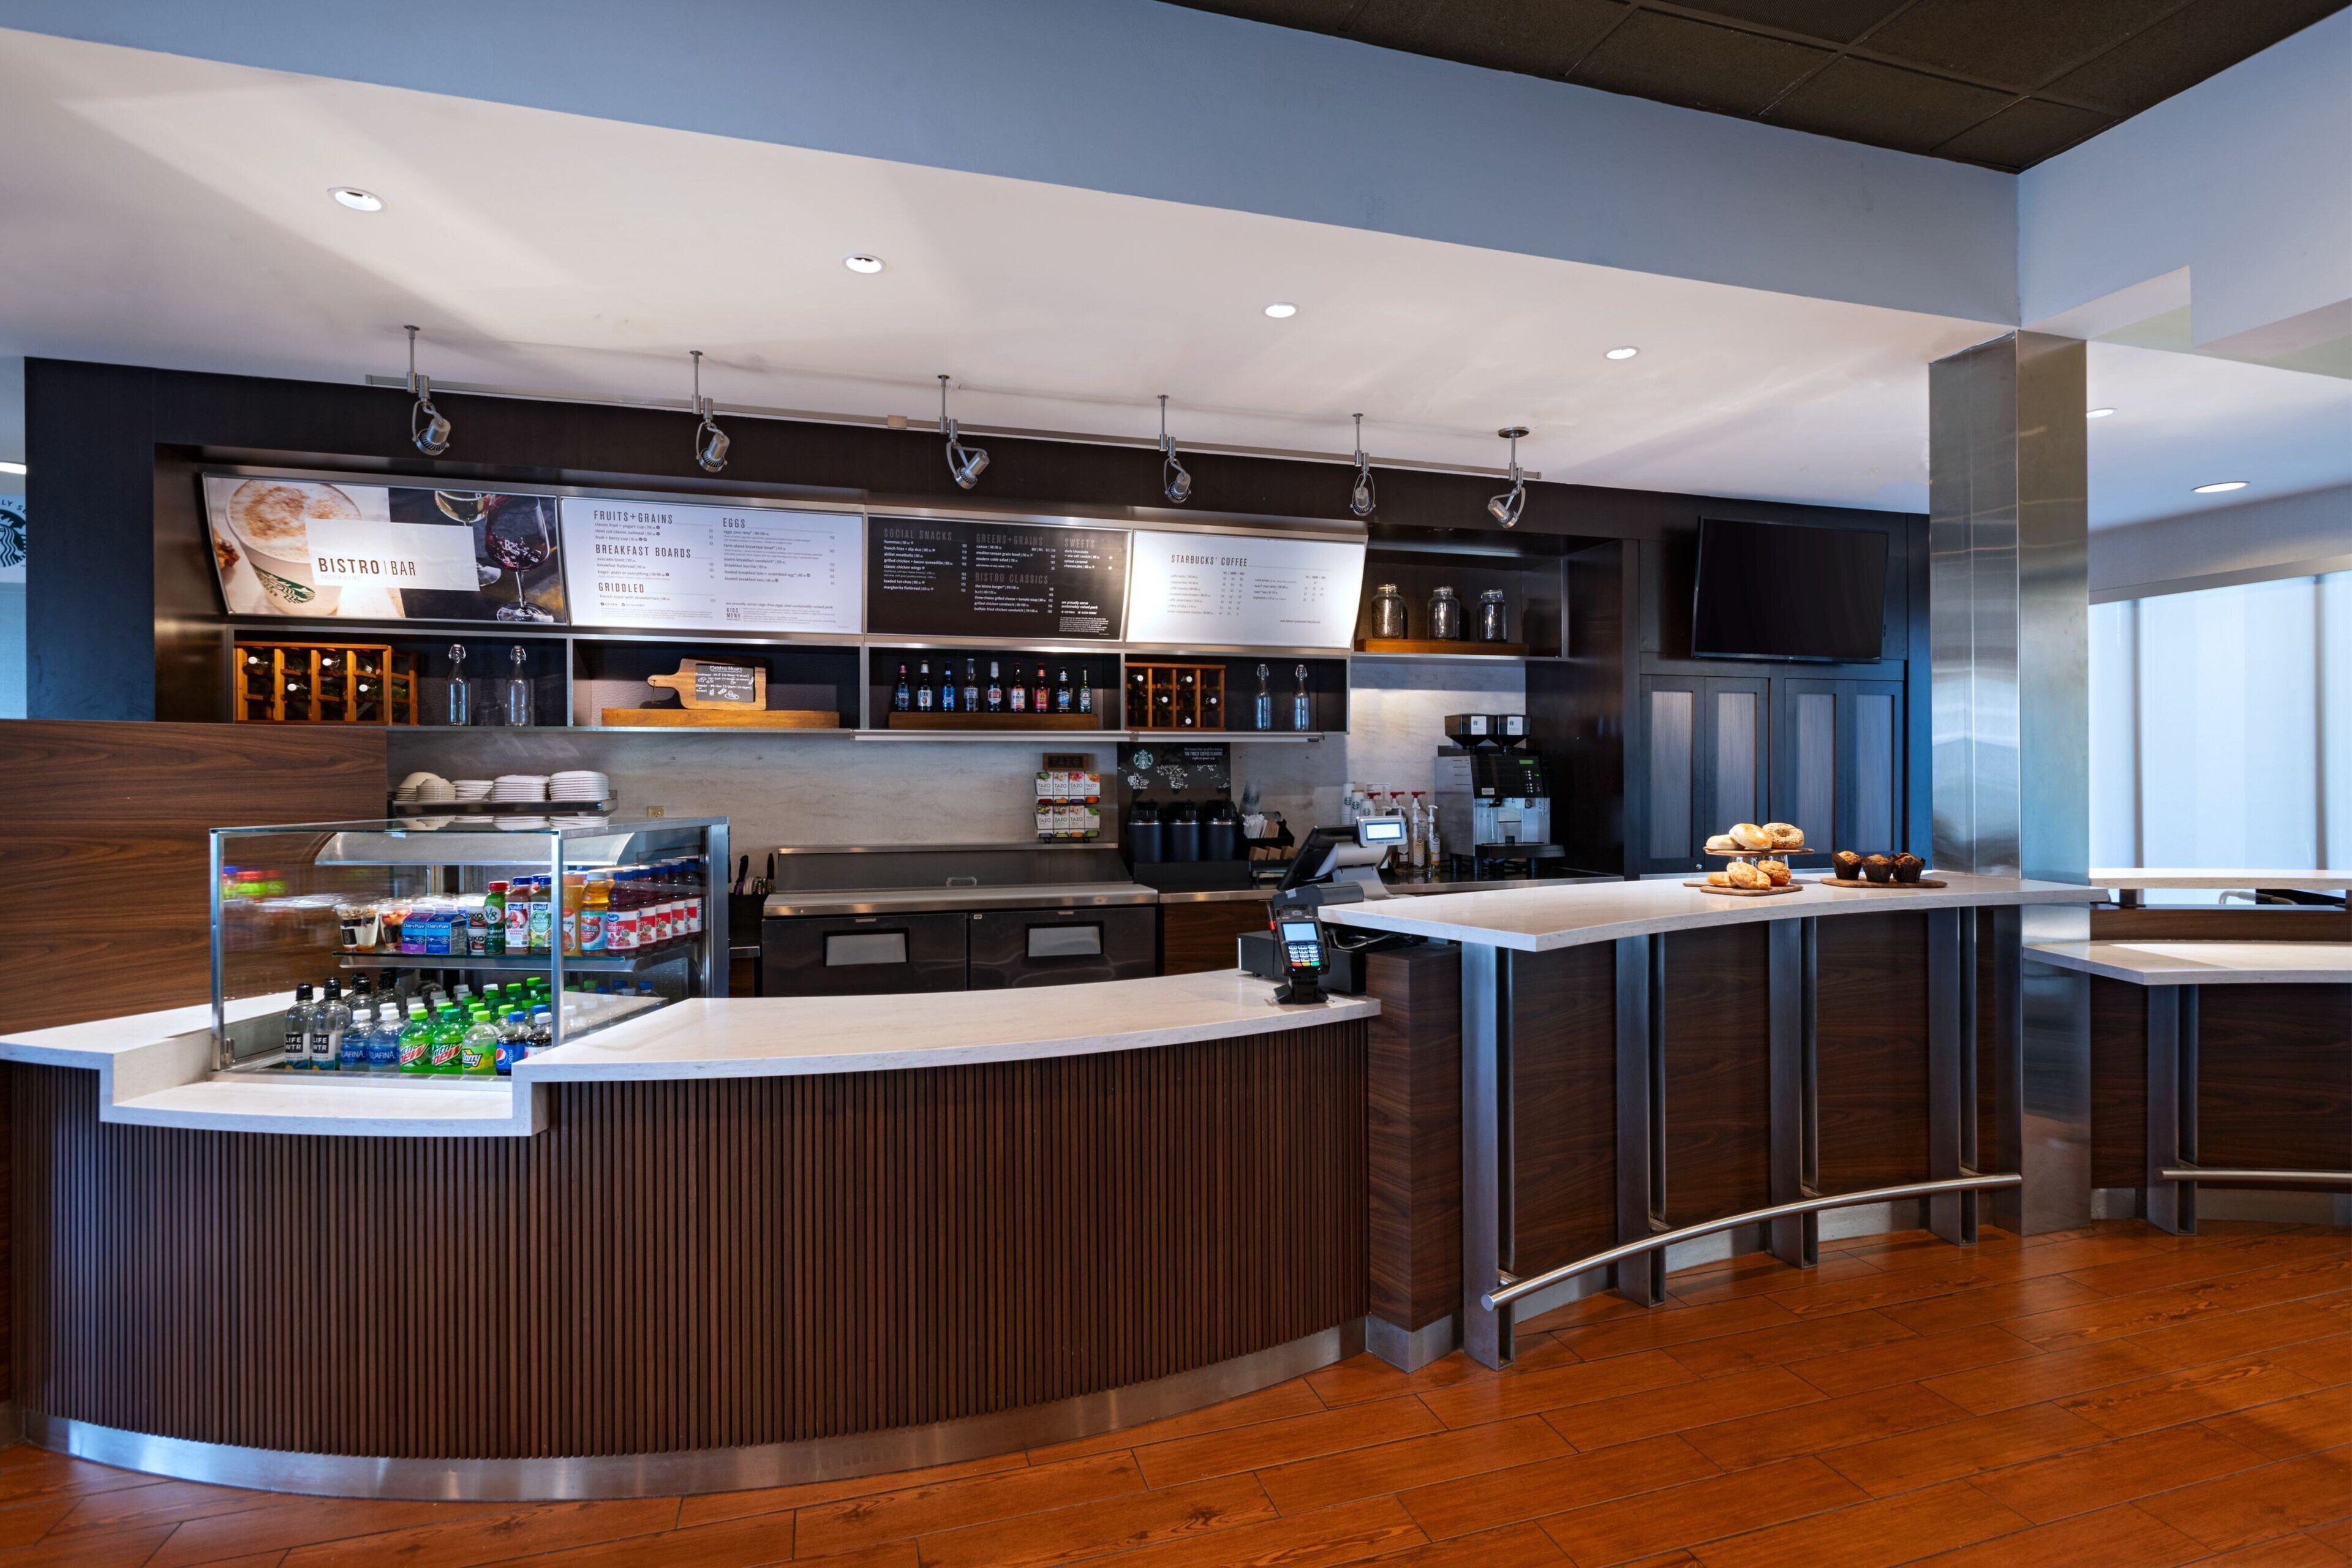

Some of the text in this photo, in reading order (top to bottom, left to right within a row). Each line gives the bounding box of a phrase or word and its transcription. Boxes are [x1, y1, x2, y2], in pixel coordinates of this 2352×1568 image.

[723, 518, 745, 528] EGGS
[884, 529, 952, 541] SOCIAL SNACKS
[1065, 538, 1095, 549] SWEETS
[596, 544, 691, 558] BREAKFAST BOARDS
[317, 557, 416, 576] BISTRO BAR
[1171, 554, 1247, 567] STARBUCKS COFFEE
[975, 572, 1048, 584] BISTRO CLASSICS
[598, 582, 644, 592] GRIDDLED
[484, 908, 497, 921] V8
